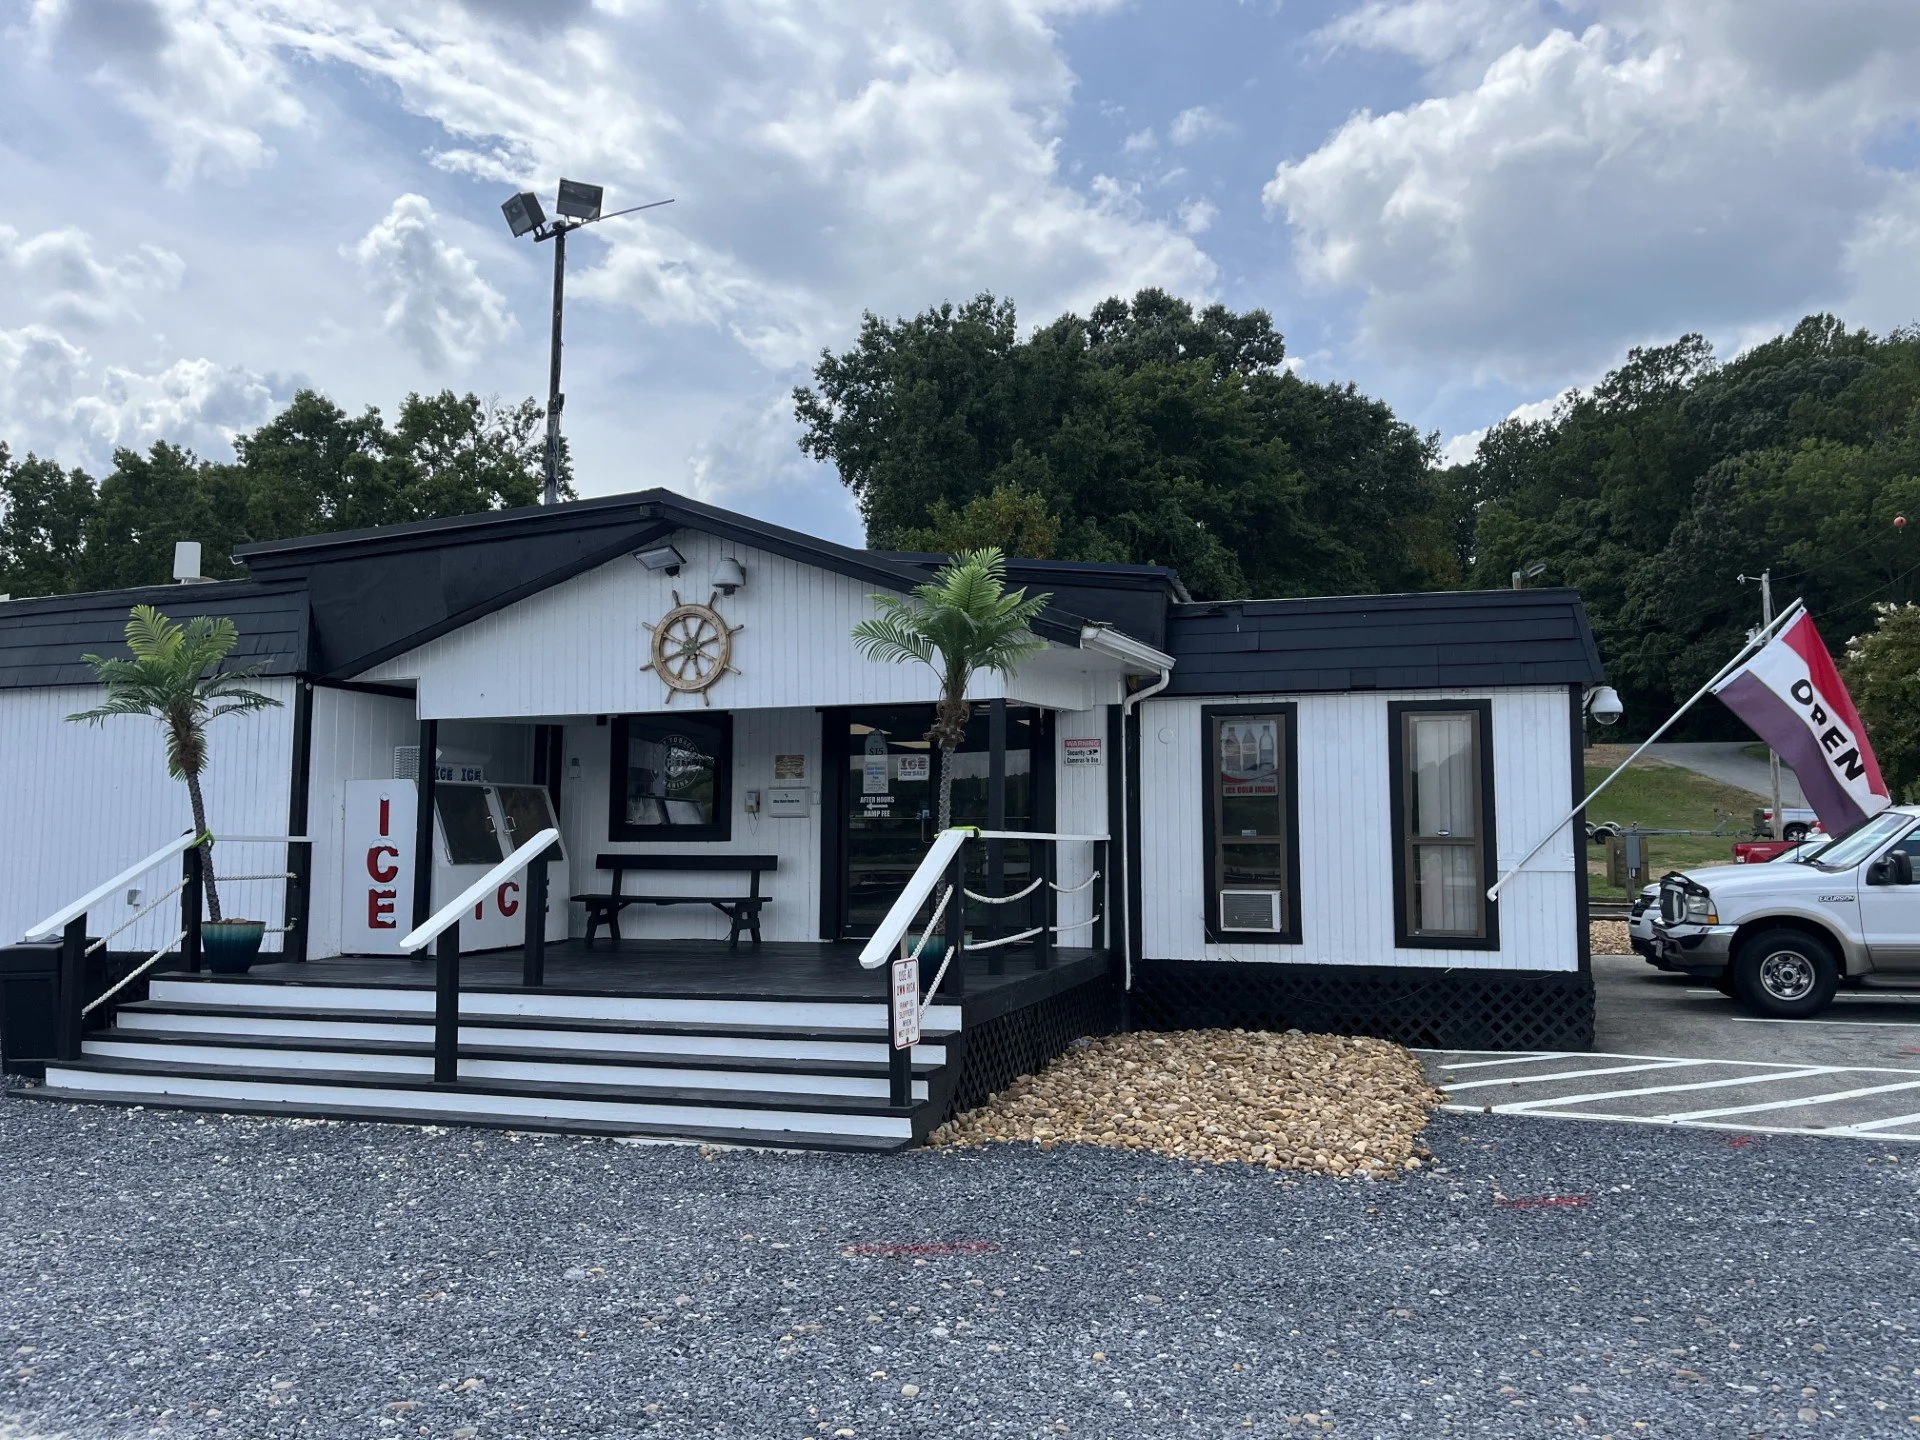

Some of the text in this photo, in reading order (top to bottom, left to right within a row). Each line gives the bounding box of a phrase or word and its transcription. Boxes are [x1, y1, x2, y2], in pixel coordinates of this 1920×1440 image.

[1790, 678, 1866, 782] OPEN
[869, 747, 884, 756] $15
[900, 757, 927, 770] ICE
[435, 766, 481, 781] ICE ICE
[1225, 786, 1236, 794] ICE
[1237, 786, 1254, 794] COLD
[860, 796, 876, 804] AFTER
[366, 792, 399, 929] ICE
[896, 982, 916, 996] OWN RISK
